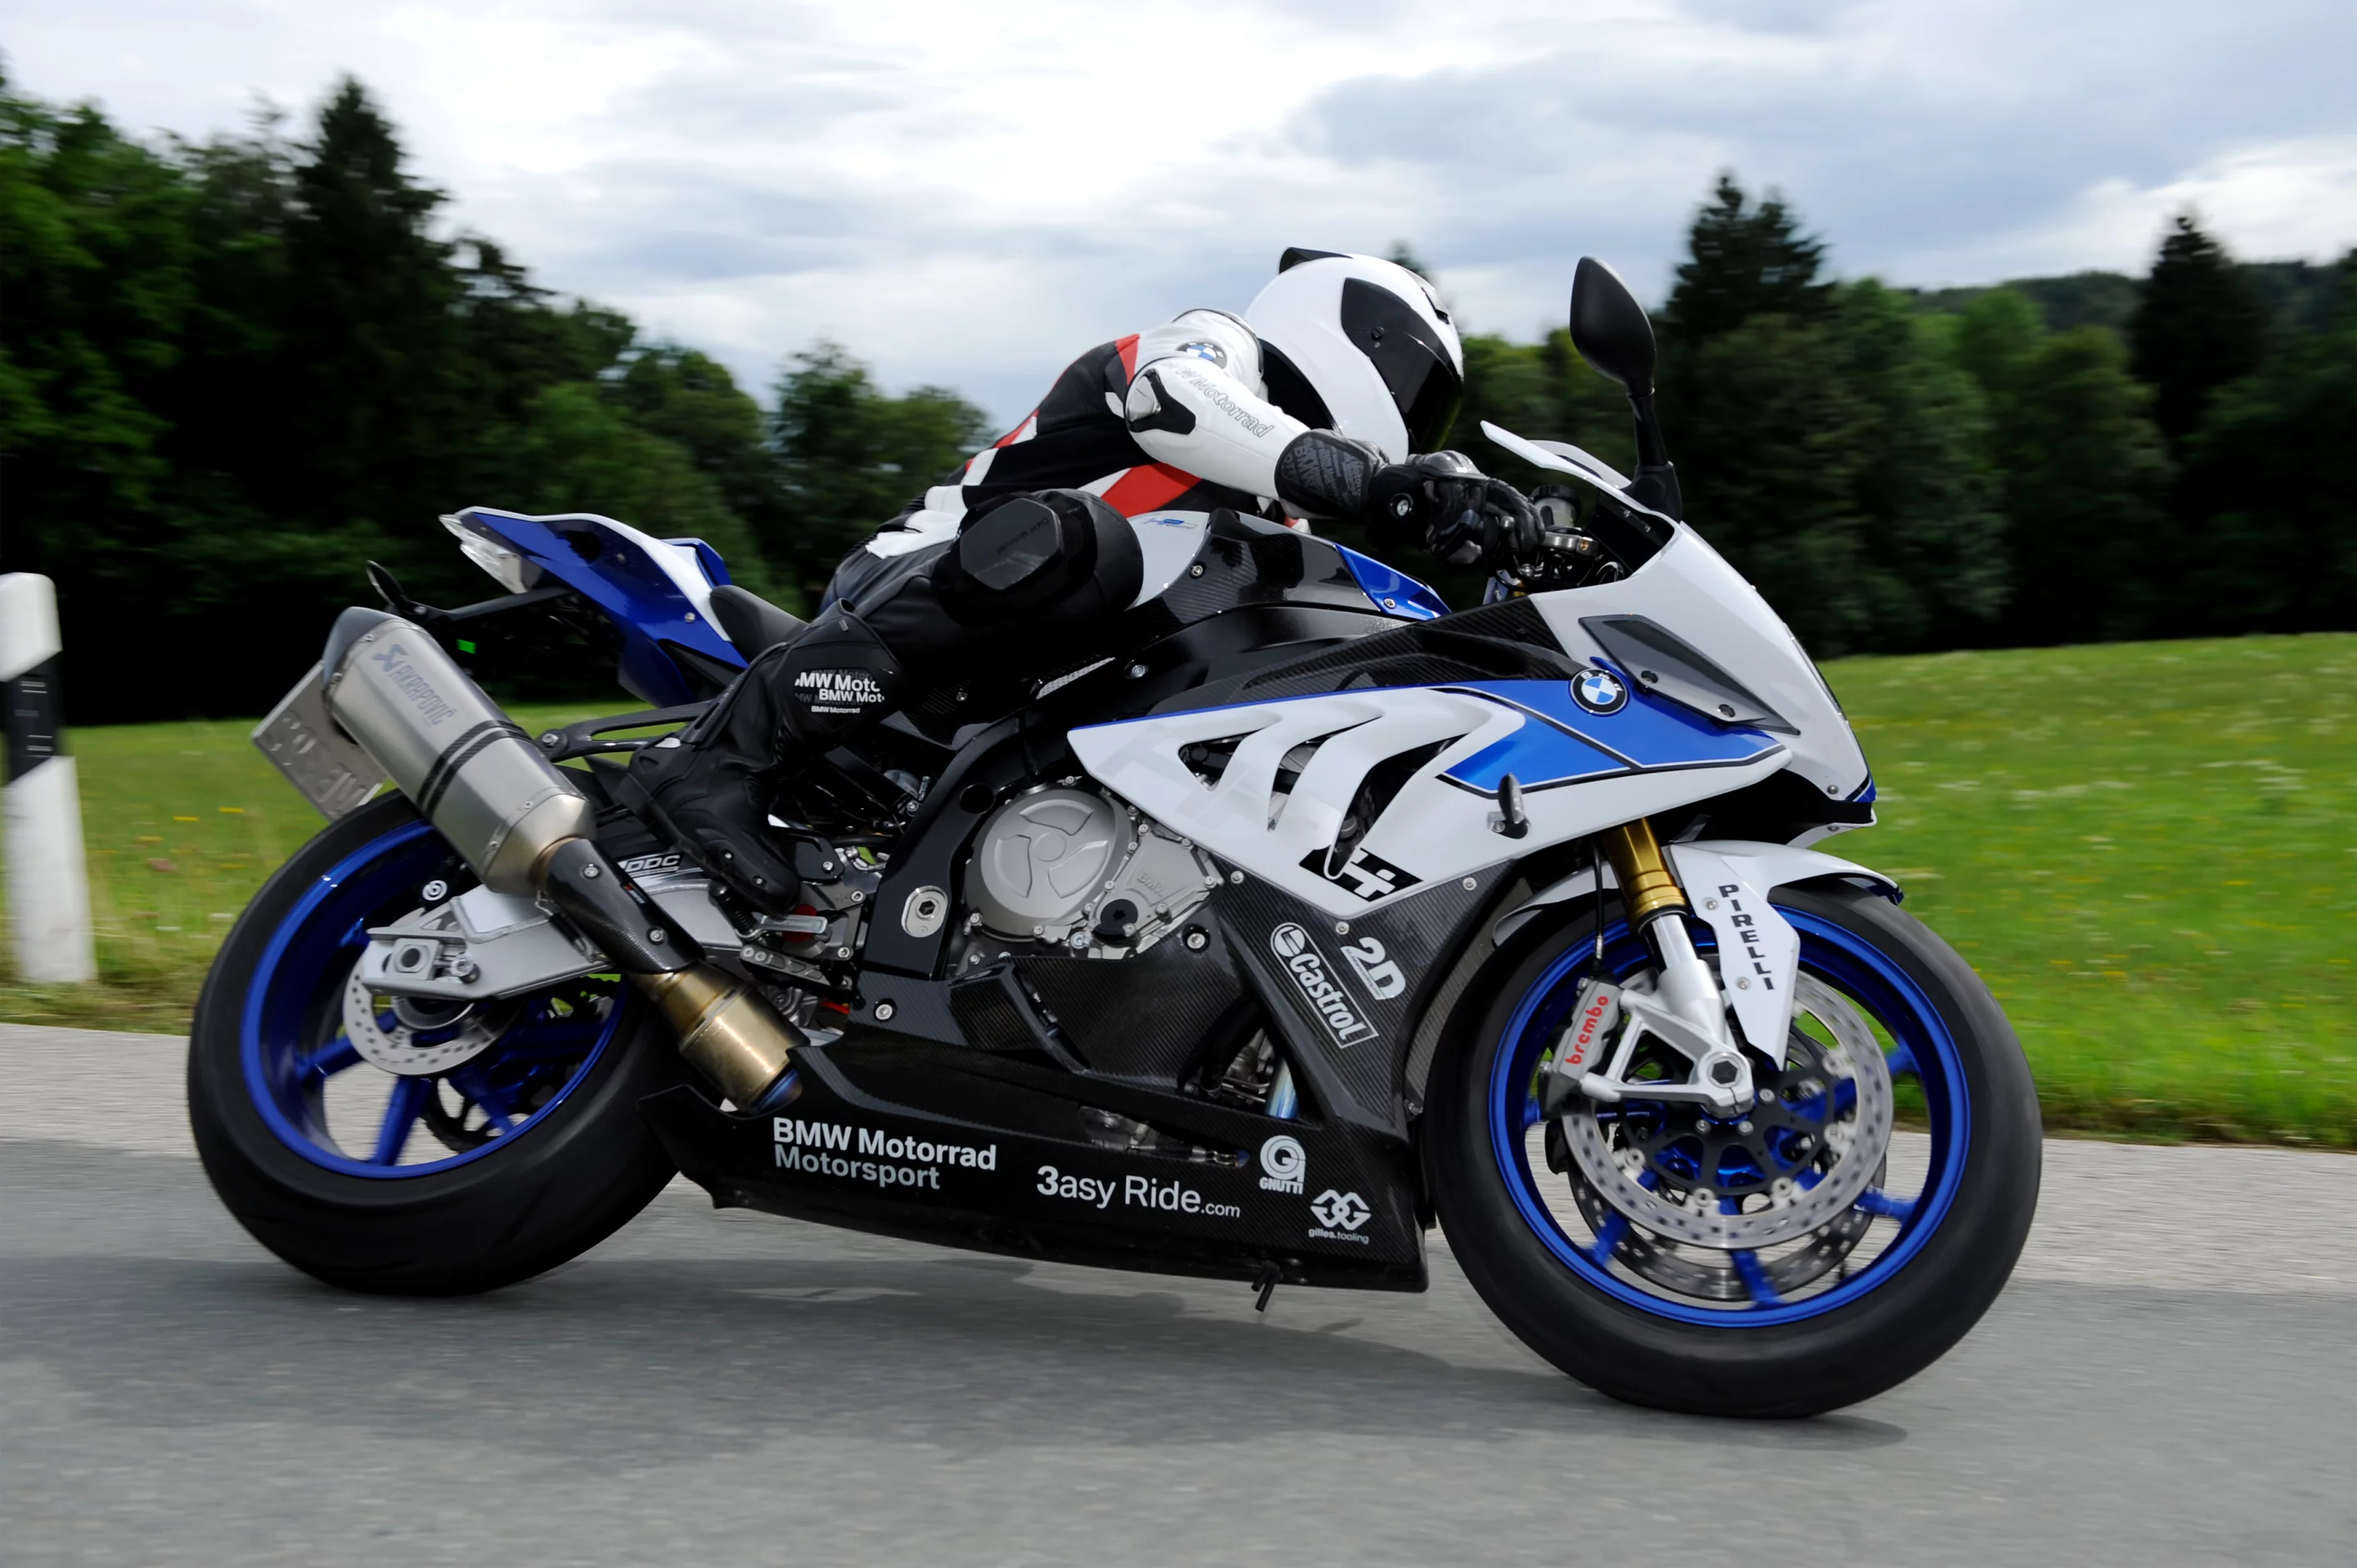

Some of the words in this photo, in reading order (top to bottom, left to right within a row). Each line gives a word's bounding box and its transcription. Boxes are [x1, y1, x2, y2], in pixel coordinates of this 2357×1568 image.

[1189, 374, 1275, 438] Motorrad
[819, 688, 854, 701] BMW
[624, 855, 680, 872] DDC
[1718, 884, 1774, 990] PIRELLI
[1341, 936, 1406, 1000] 2D
[1290, 953, 1367, 1040] Castrol
[1565, 995, 1608, 1065] brembo
[773, 1116, 851, 1151] BMW
[859, 1128, 997, 1171] Motorrad
[775, 1144, 940, 1189] Motorsport
[1036, 1165, 1116, 1209] 3asy
[1259, 1176, 1304, 1195] GNUTTI
[1308, 1228, 1370, 1245] gilles.tooling
